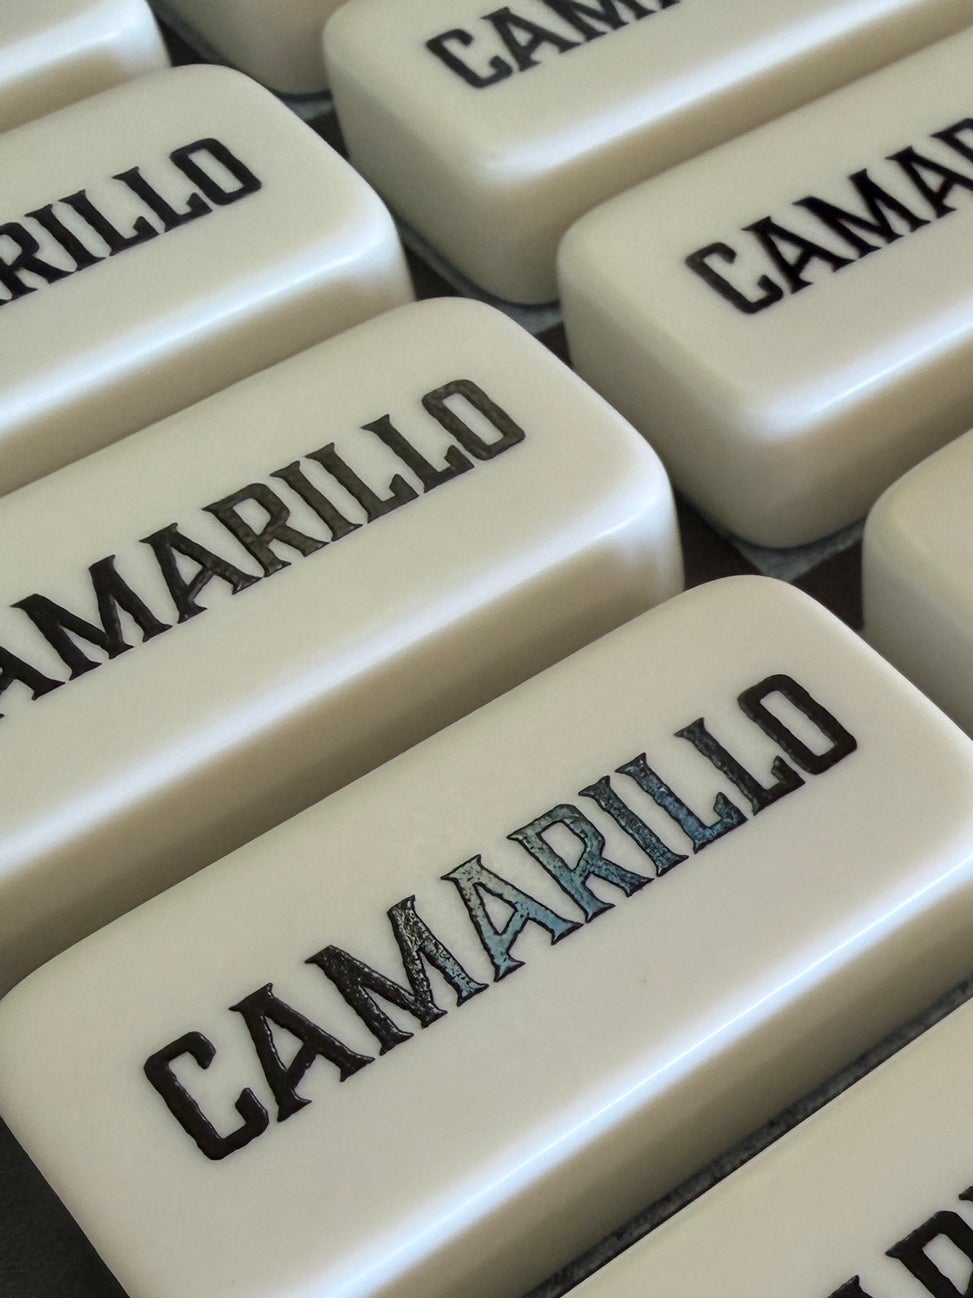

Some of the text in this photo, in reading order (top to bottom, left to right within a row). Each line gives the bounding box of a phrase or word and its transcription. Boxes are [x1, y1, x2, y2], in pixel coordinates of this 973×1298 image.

[424, 0, 681, 90] CAM
[0, 137, 263, 307] RILLO
[142, 673, 859, 1162] CAMARILLO
